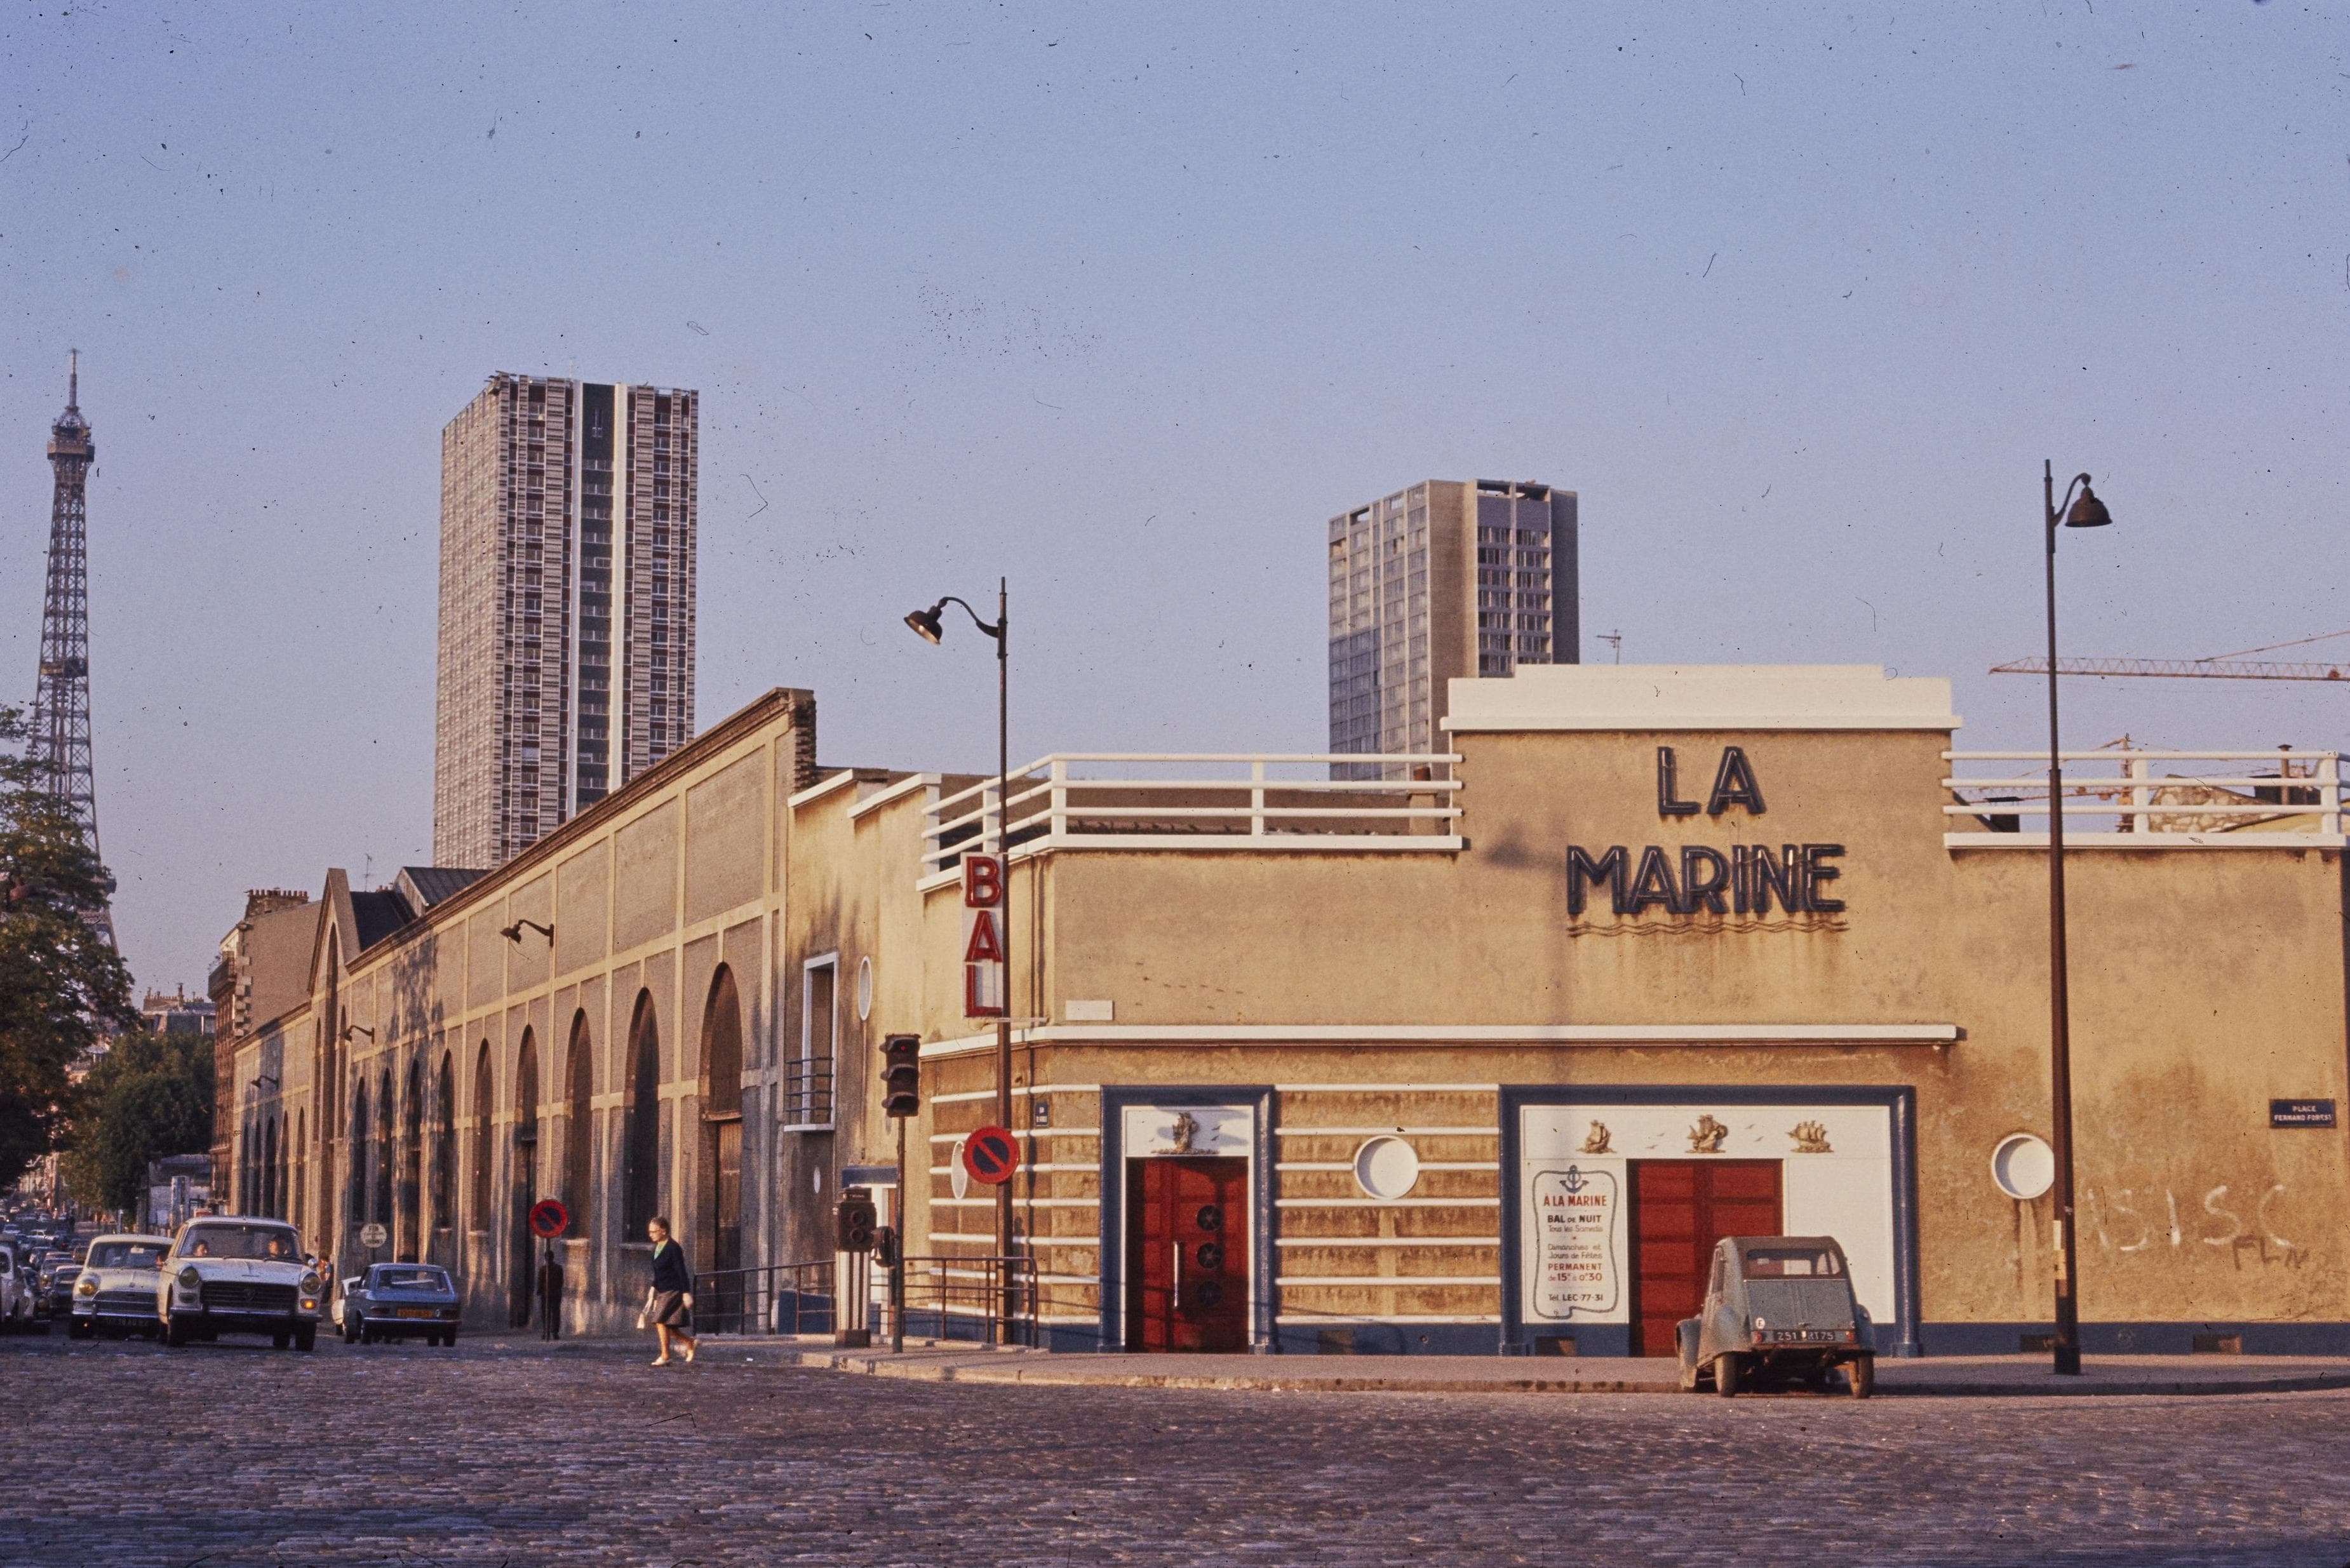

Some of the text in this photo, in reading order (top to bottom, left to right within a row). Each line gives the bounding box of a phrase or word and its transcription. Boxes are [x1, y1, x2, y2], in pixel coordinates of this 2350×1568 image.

[1656, 746, 1767, 815] LA
[1566, 843, 1846, 915] MARINE
[964, 856, 1003, 1018] BAL
[1547, 1214, 1566, 1224] BAL
[1579, 1214, 1602, 1224] NUIT
[1552, 1195, 1565, 1207] LA
[1568, 1195, 1608, 1207] MARINE
[1548, 1263, 1603, 1271] PERMANENT
